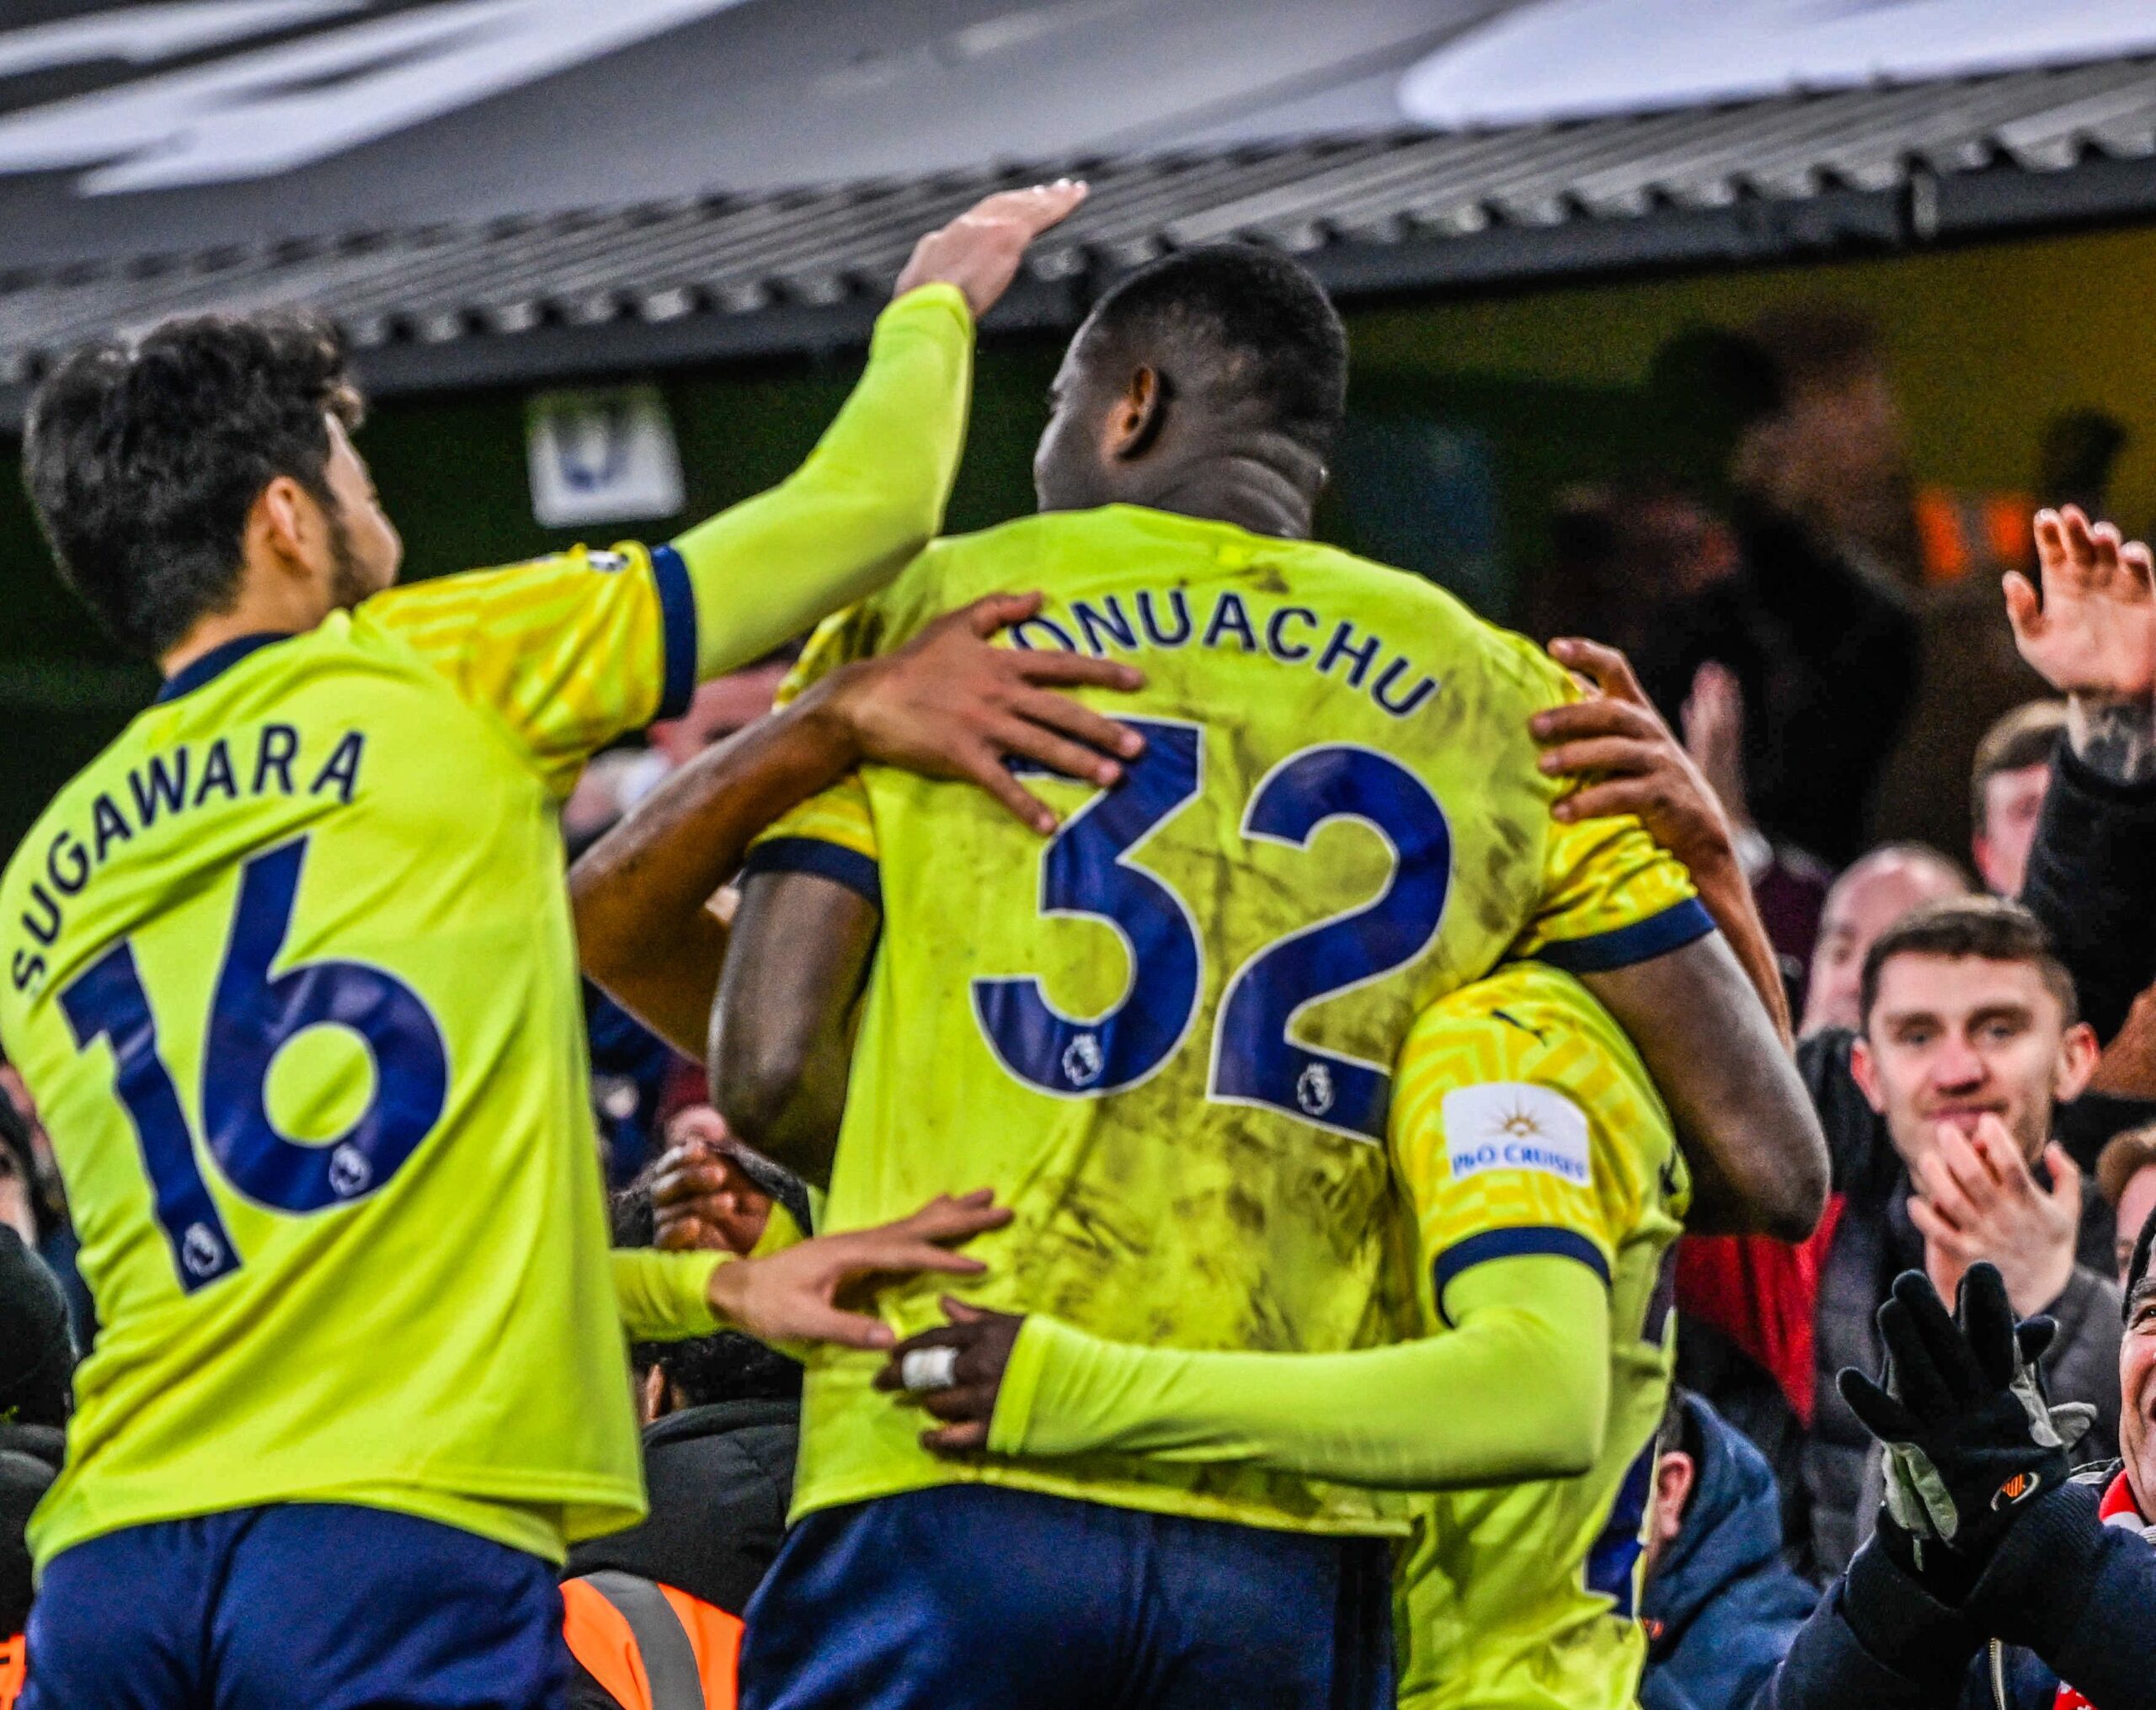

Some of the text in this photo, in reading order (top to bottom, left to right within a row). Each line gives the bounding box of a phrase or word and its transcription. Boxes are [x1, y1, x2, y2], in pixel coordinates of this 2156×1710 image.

[1011, 590, 1437, 718] ONUACHU
[11, 724, 366, 993] SUGAWARA
[970, 712, 1453, 1145] 32
[56, 828, 451, 1297] 16
